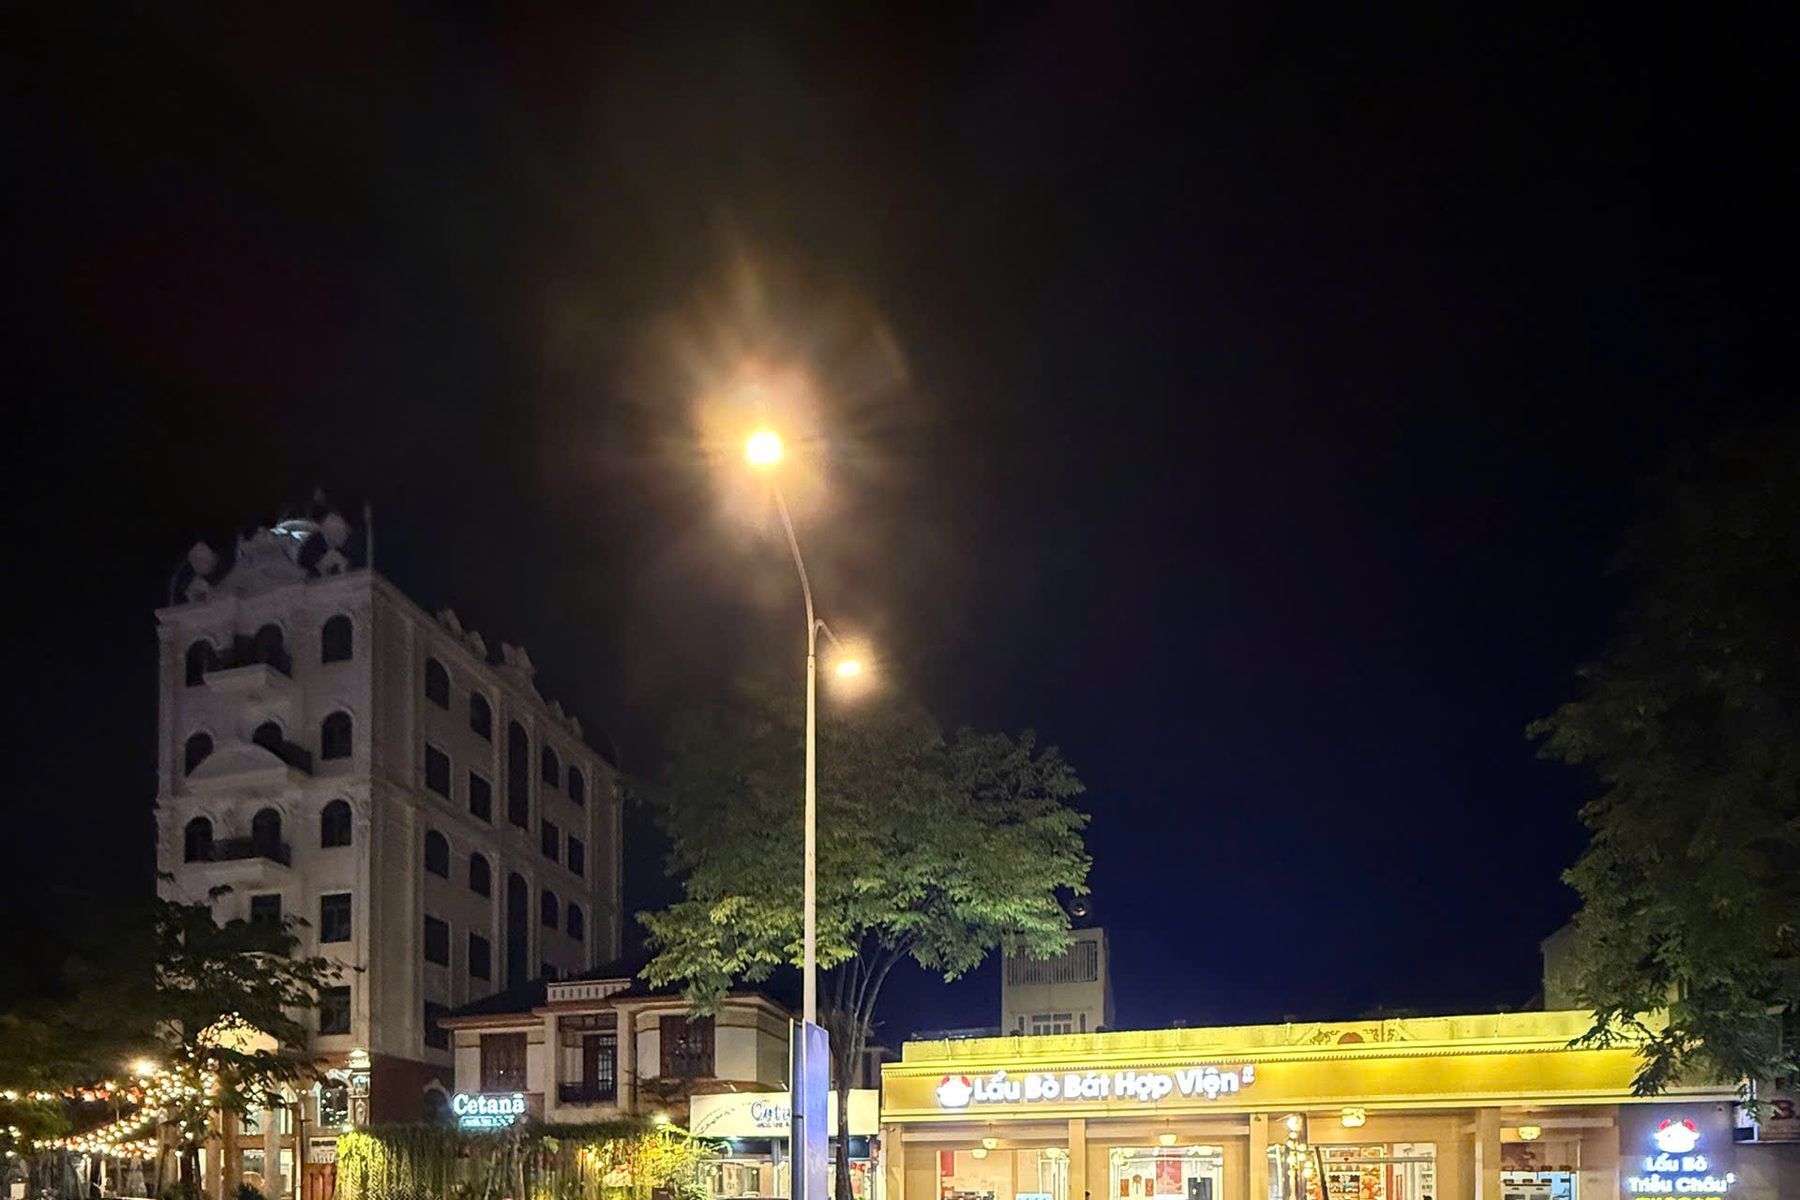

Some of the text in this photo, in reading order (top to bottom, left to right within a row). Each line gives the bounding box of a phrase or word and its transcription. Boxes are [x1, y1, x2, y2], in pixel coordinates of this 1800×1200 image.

[1025, 1073, 1060, 1099] Bò
[1064, 1071, 1110, 1098] Bát
[1114, 1071, 1173, 1101] Hợp
[1175, 1067, 1239, 1099] Viện
[1682, 1155, 1708, 1172] Bò
